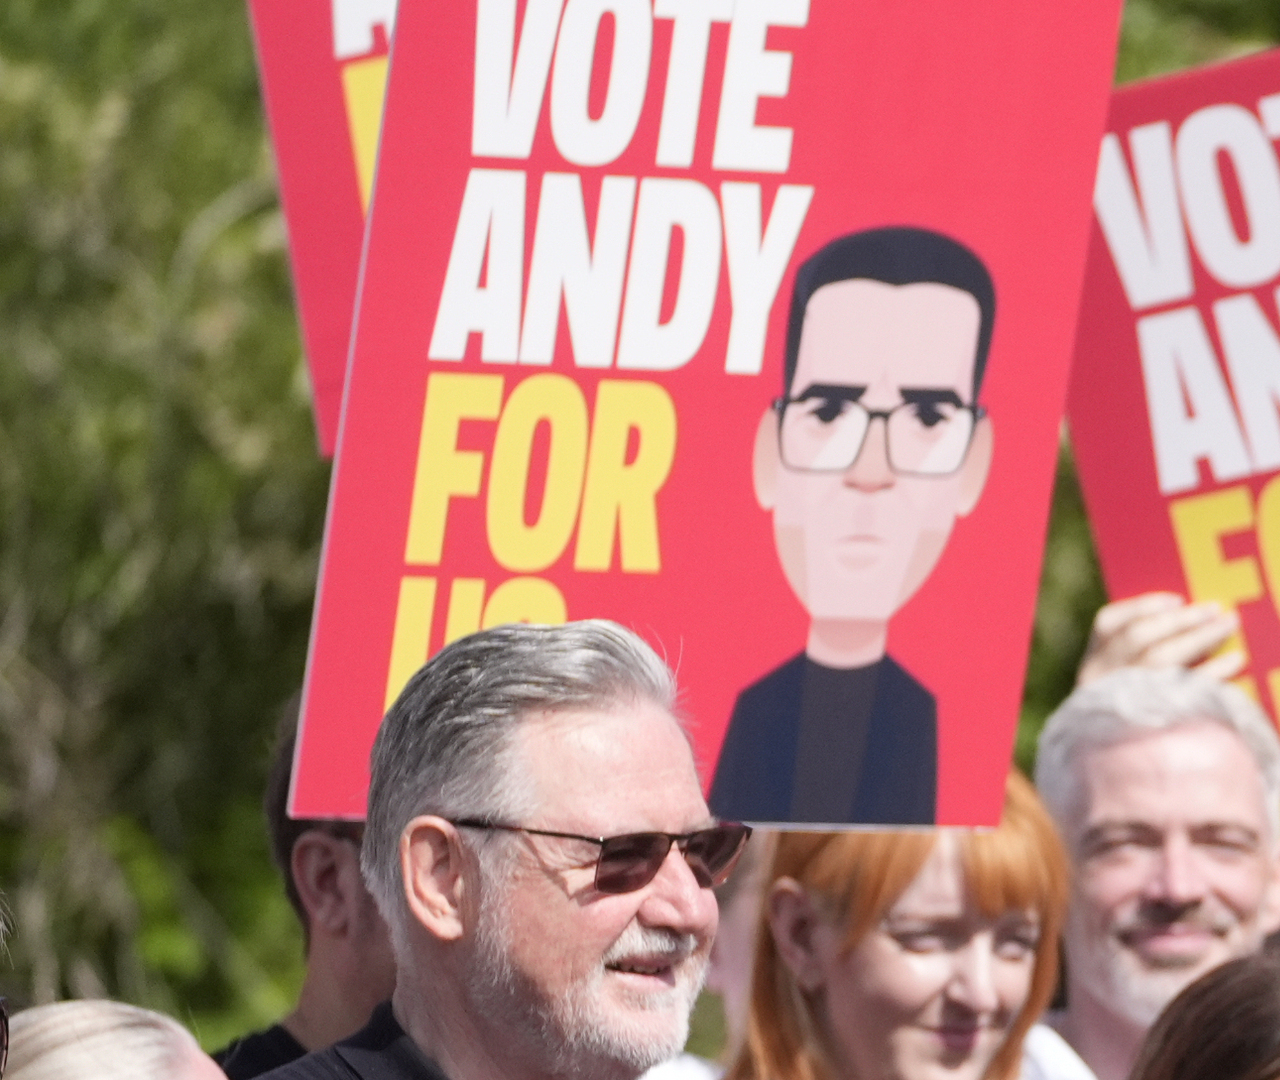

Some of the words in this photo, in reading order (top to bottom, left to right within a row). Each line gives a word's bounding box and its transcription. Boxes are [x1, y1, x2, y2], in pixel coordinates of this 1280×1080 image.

[470, 0, 808, 173] VOTE
[427, 168, 815, 375] ANDY
[404, 372, 678, 574] FOR
